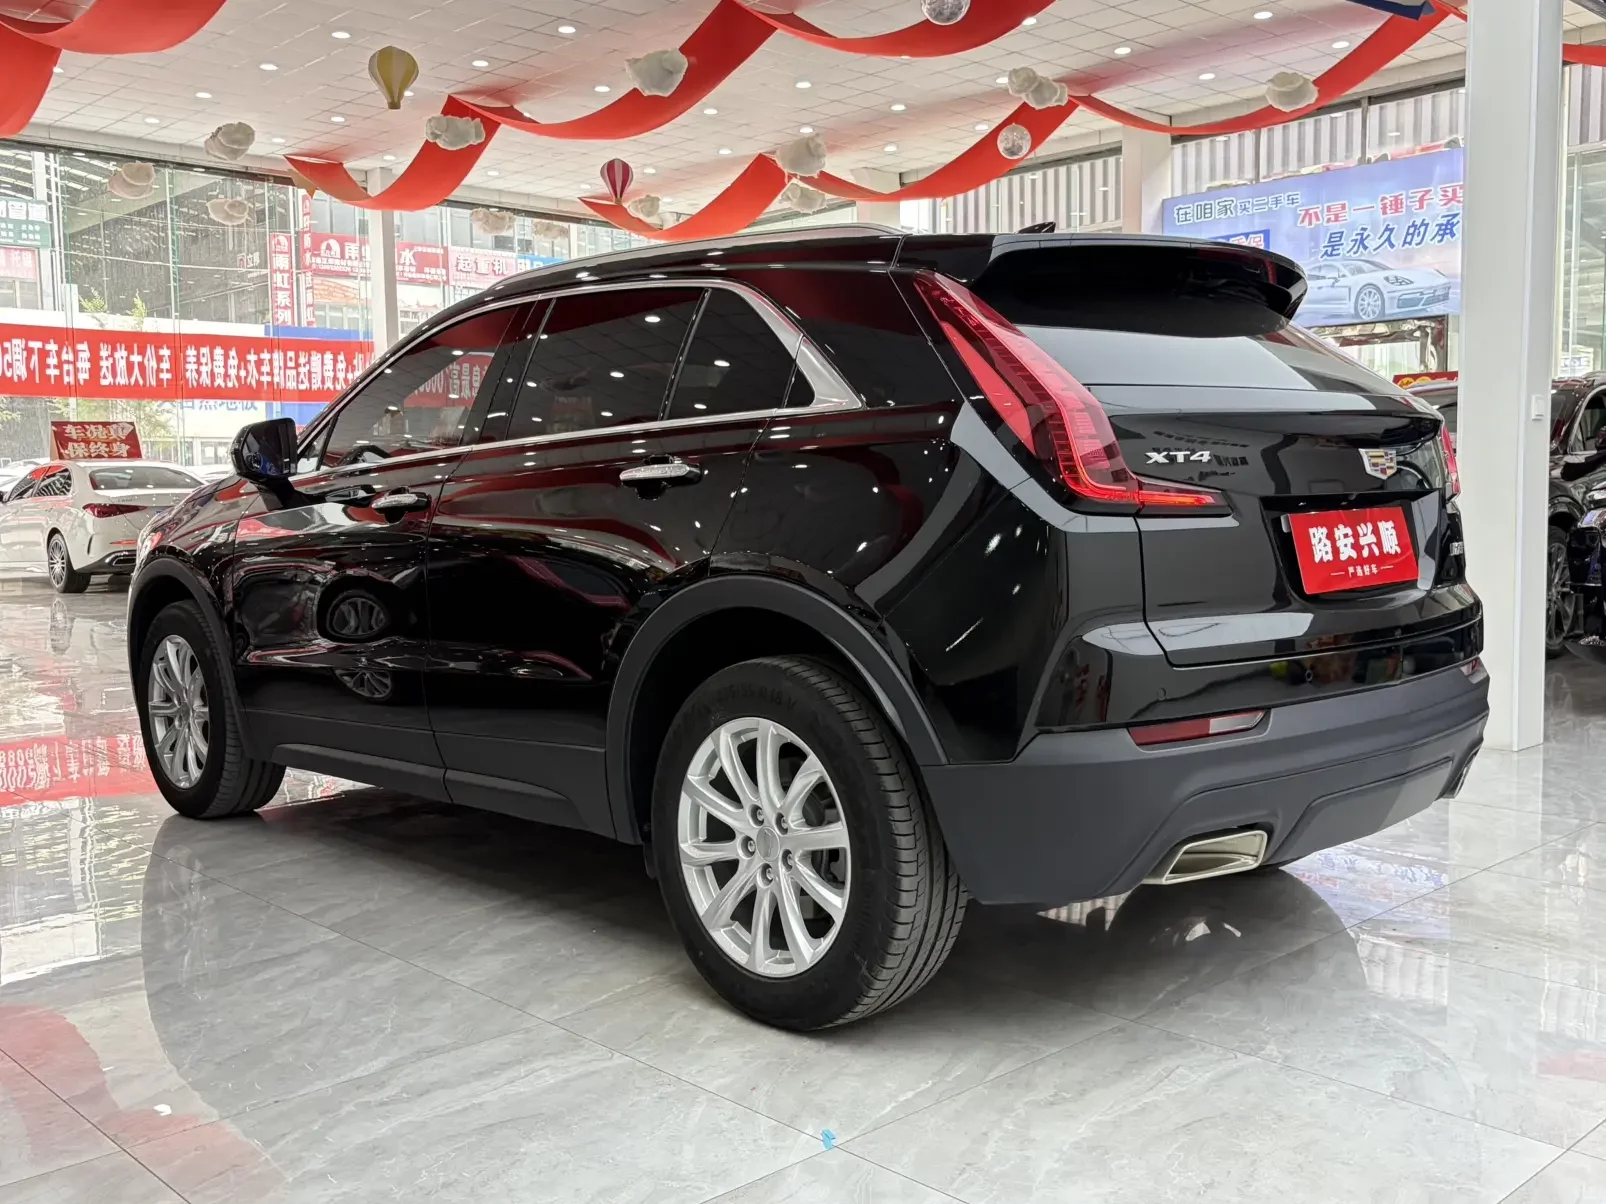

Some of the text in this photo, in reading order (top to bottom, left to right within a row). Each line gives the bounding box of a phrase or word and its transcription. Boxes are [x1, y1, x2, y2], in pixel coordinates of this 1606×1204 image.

[1319, 211, 1462, 260] 是永久的承
[455, 253, 509, 277] 起重机
[1144, 450, 1212, 464] XT4
[1308, 519, 1402, 564] 路安兴顺
